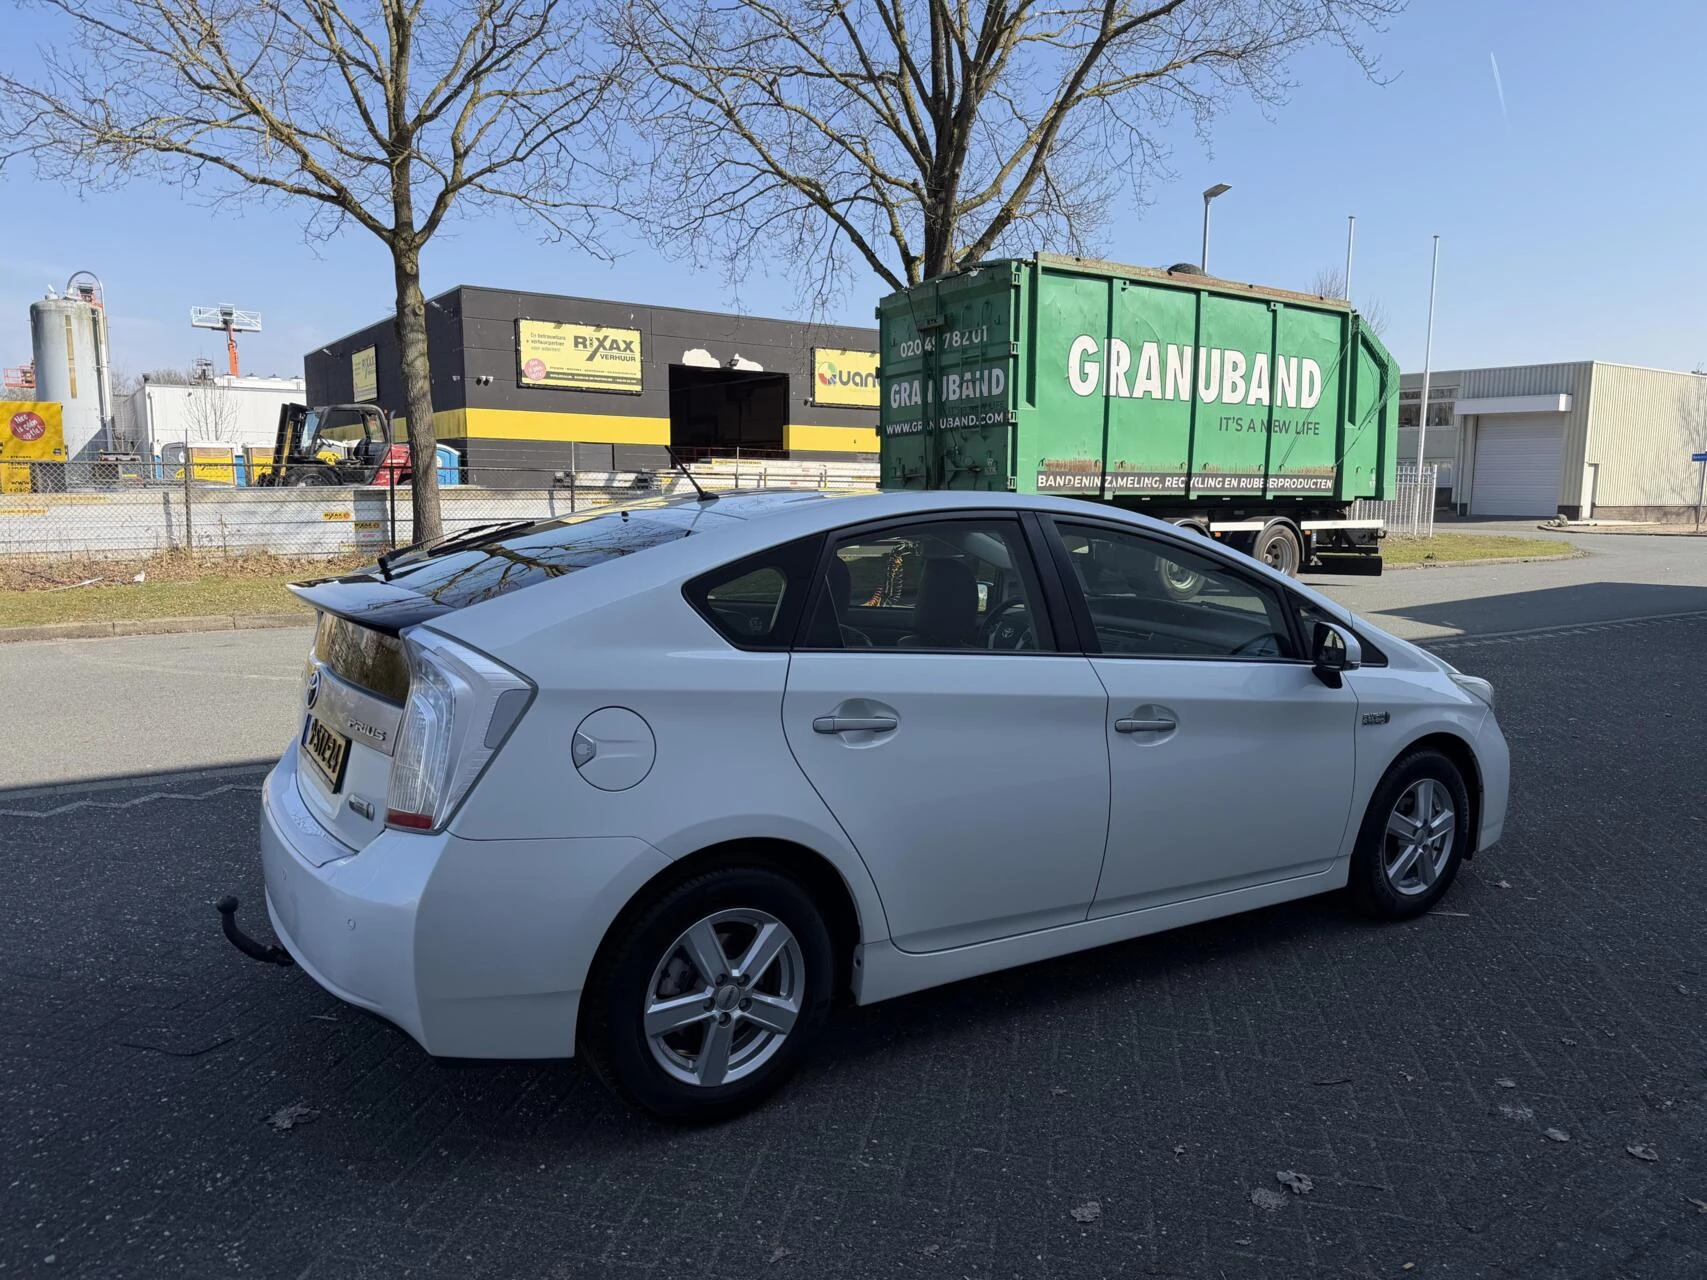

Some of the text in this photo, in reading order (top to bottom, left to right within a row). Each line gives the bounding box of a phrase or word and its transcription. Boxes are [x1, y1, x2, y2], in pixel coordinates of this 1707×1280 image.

[600, 353, 636, 362] VERHUUR
[900, 339, 922, 358] 020
[1067, 334, 1322, 409] GRANUBAND
[1219, 416, 1320, 435] IT'S A NEW LIFE
[1224, 478, 1238, 488] EN
[347, 719, 387, 741] PRIUS
